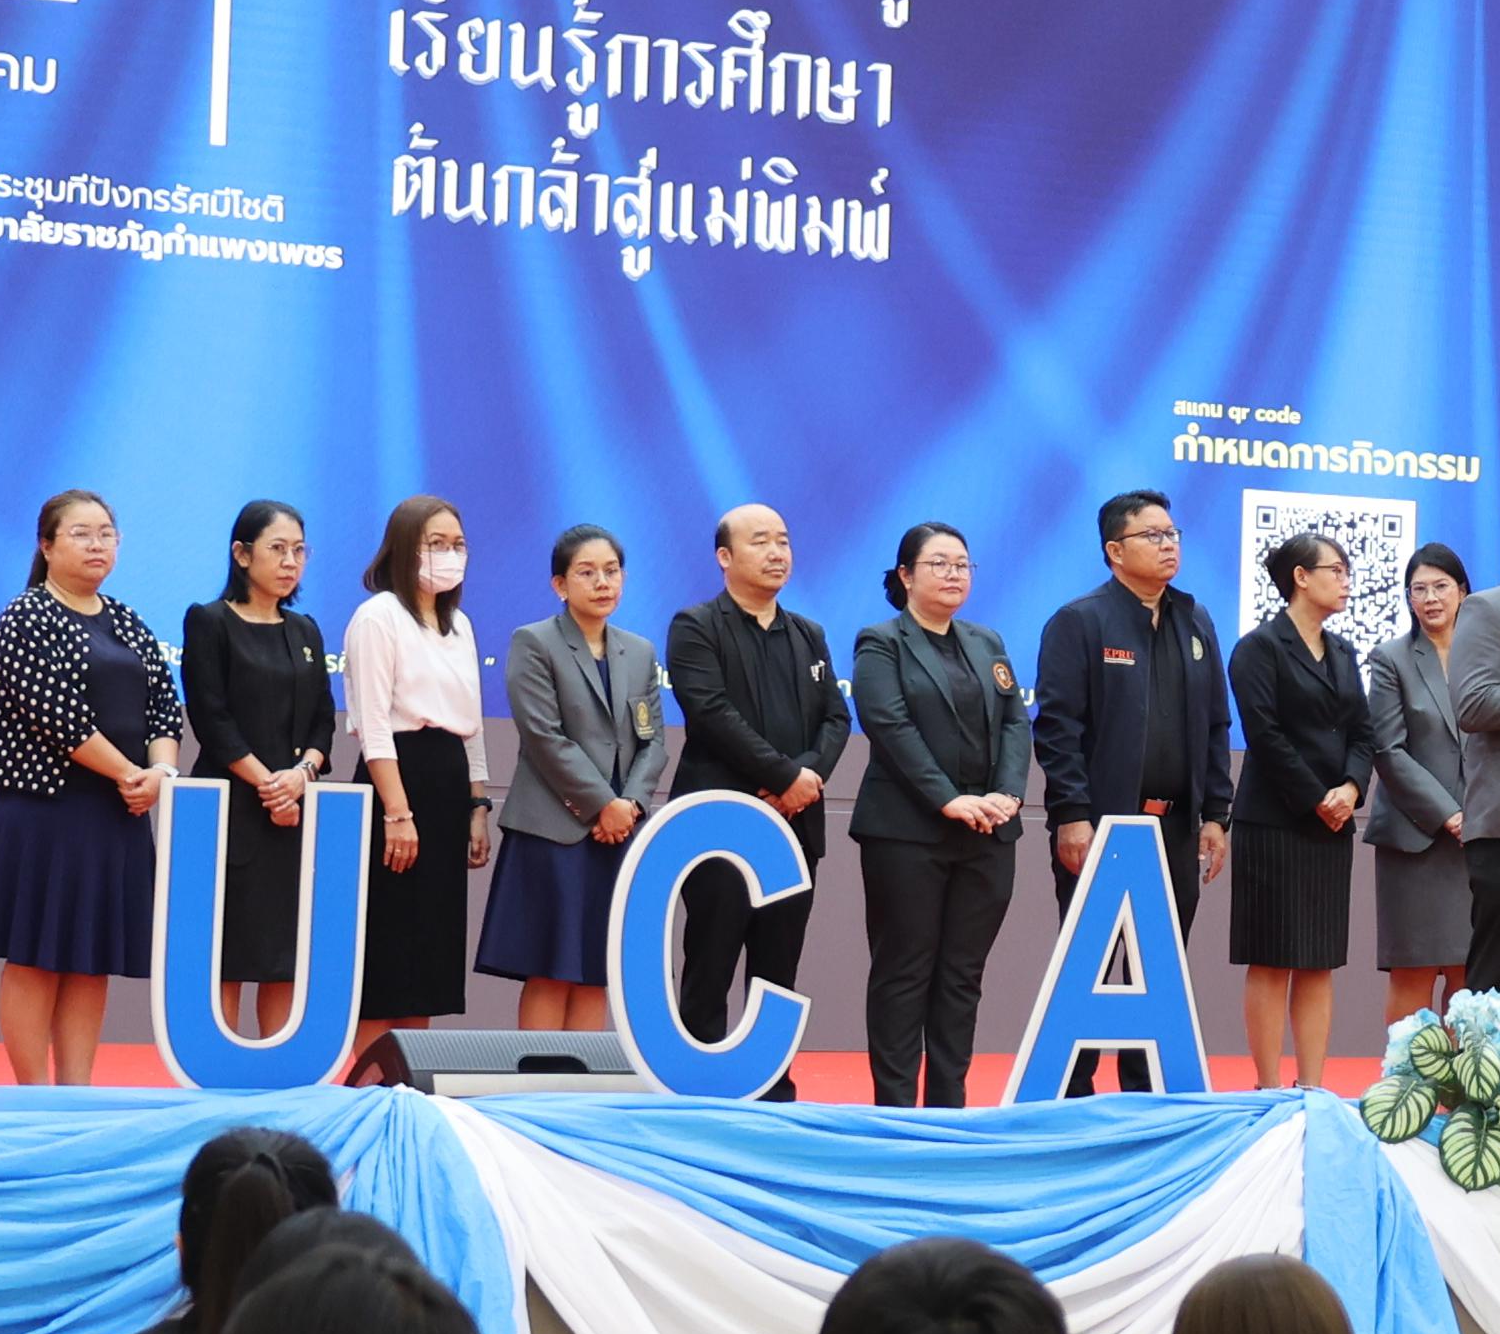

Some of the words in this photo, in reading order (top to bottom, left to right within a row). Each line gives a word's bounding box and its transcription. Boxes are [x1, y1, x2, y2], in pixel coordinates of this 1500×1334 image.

[391, 121, 891, 282] ต้นกล้าสู่แม่พิมพ์
[1173, 399, 1223, 419] สแกน
[1227, 405, 1251, 425] qr
[1254, 407, 1302, 425] code
[1172, 422, 1481, 483] กำหนดการกิจกรรม
